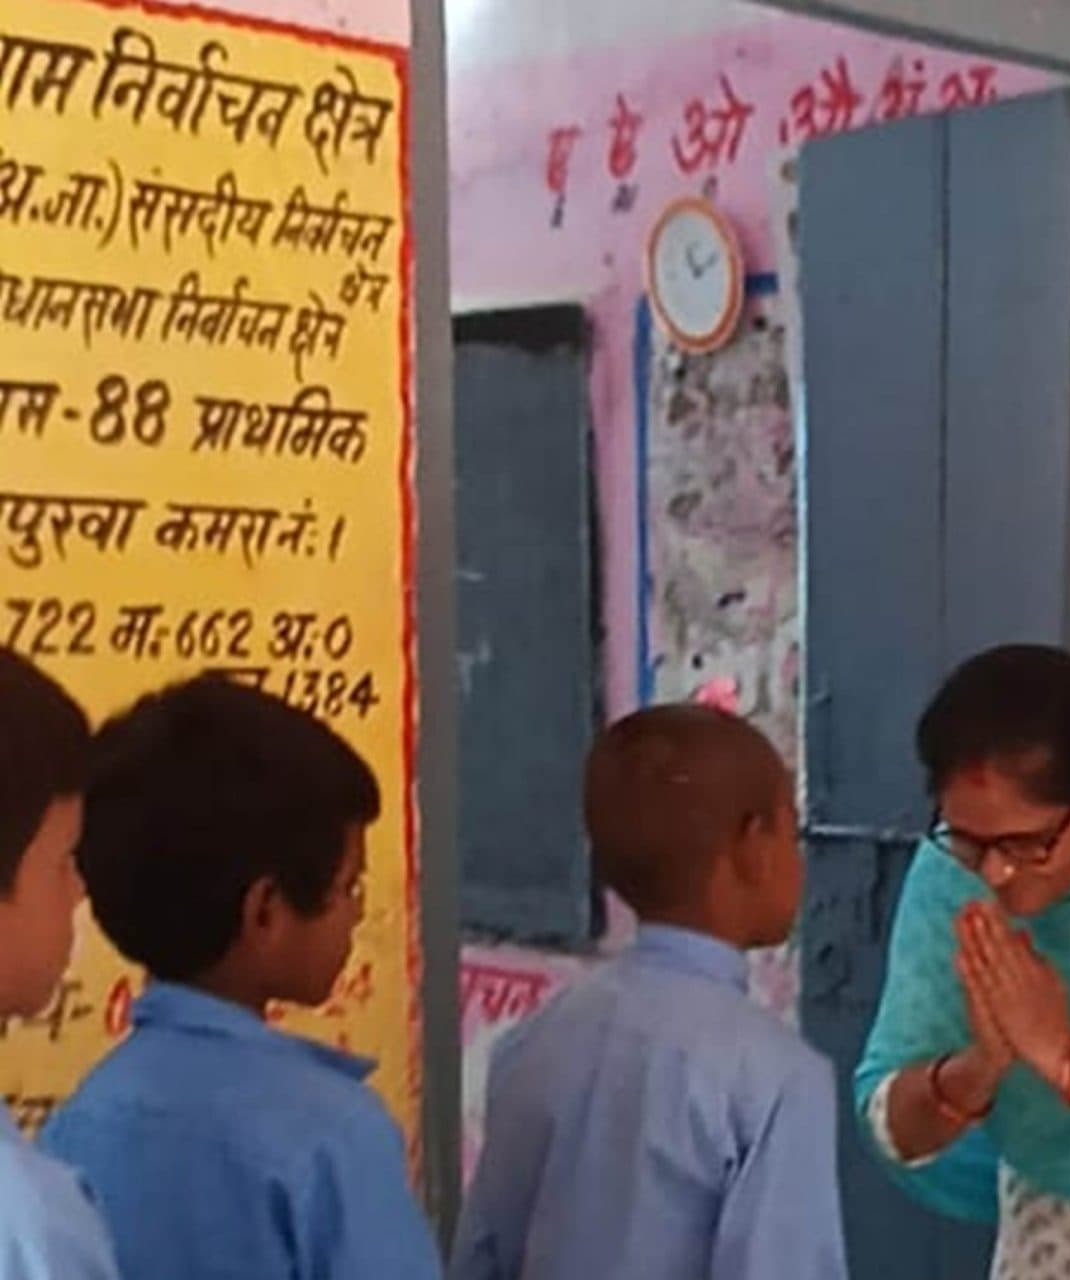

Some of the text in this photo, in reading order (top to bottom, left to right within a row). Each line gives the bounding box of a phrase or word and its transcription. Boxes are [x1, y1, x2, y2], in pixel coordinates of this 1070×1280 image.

[93, 26, 304, 147] निर्वाचन
[304, 63, 393, 175] क्षेत्र
[670, 72, 754, 174] ओ
[272, 185, 394, 262] निर्वाचन
[0, 270, 159, 350] धानसभा
[161, 271, 290, 352] निर्वाचन
[190, 385, 368, 465] प्राथमिक
[0, 494, 147, 568] पुरवा
